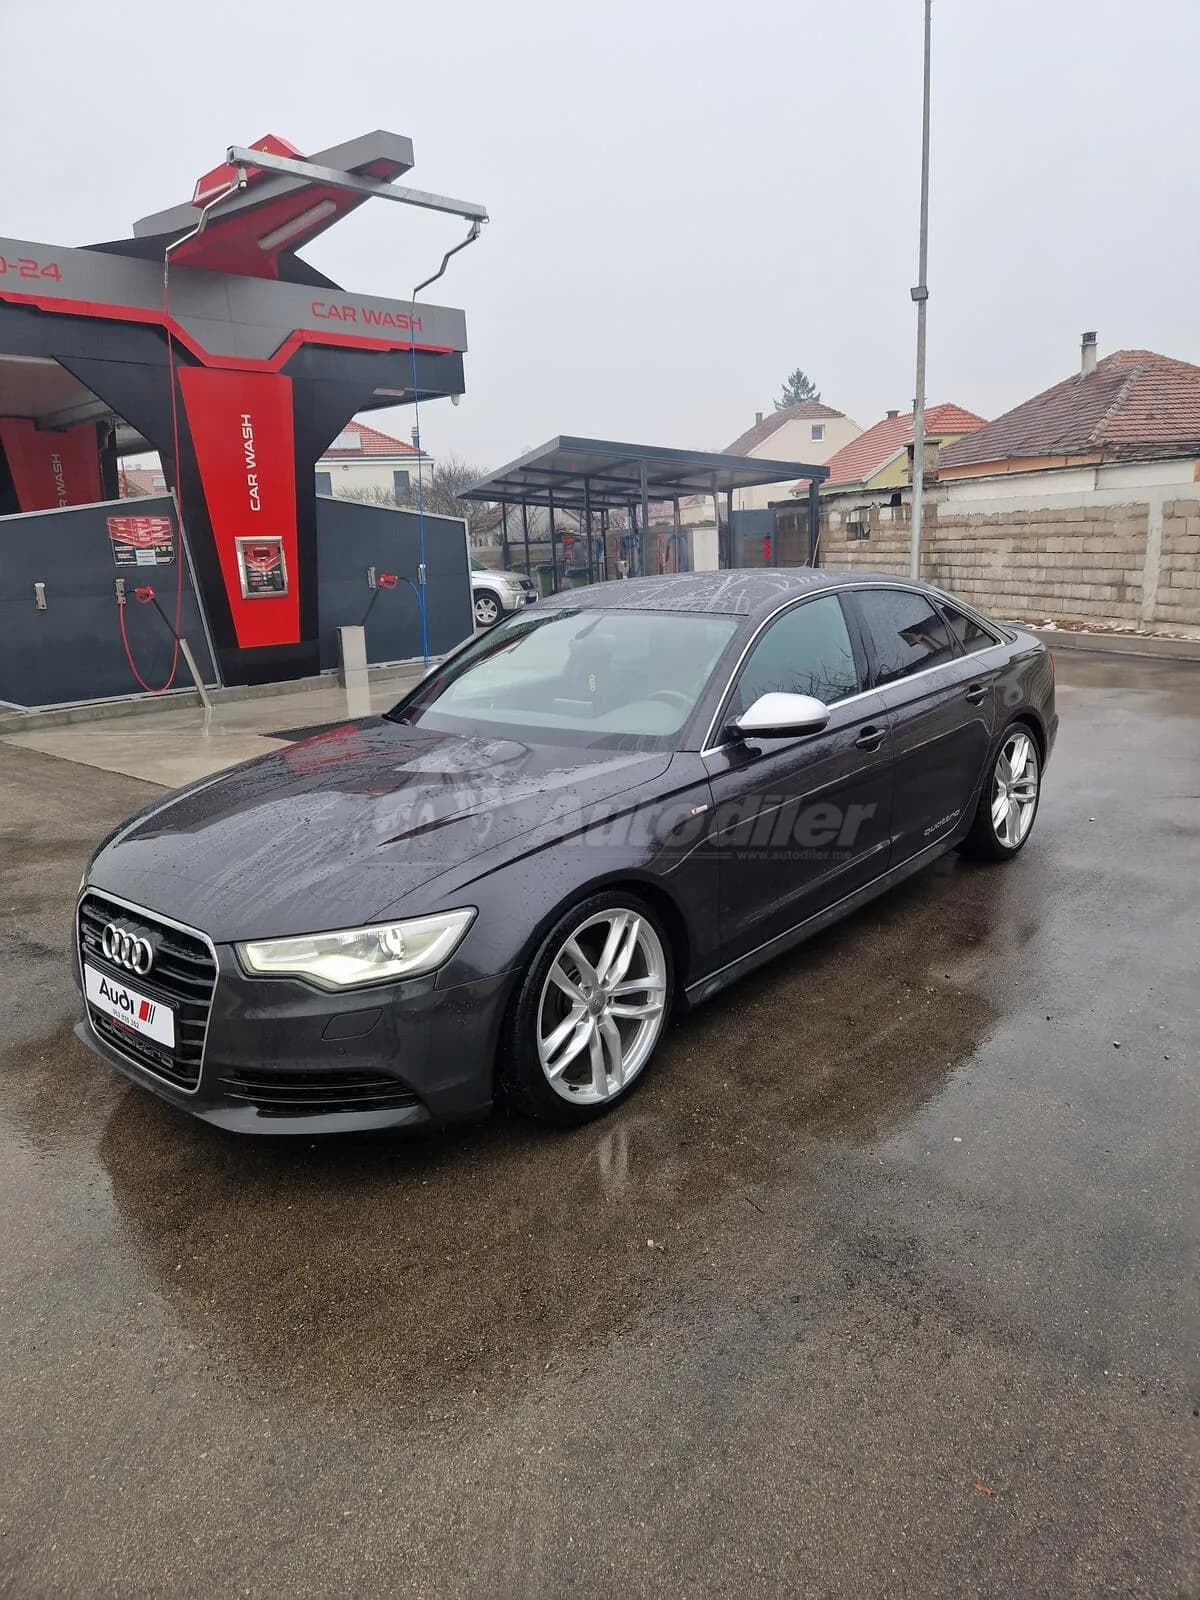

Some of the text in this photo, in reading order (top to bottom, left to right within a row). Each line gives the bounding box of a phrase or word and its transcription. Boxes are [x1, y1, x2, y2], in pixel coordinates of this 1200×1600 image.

[311, 302, 422, 332] CAR WASH
[51, 453, 67, 496] WASH
[240, 414, 261, 511] CAR WASH
[923, 809, 960, 836] quattro
[99, 977, 134, 1015] Audi
